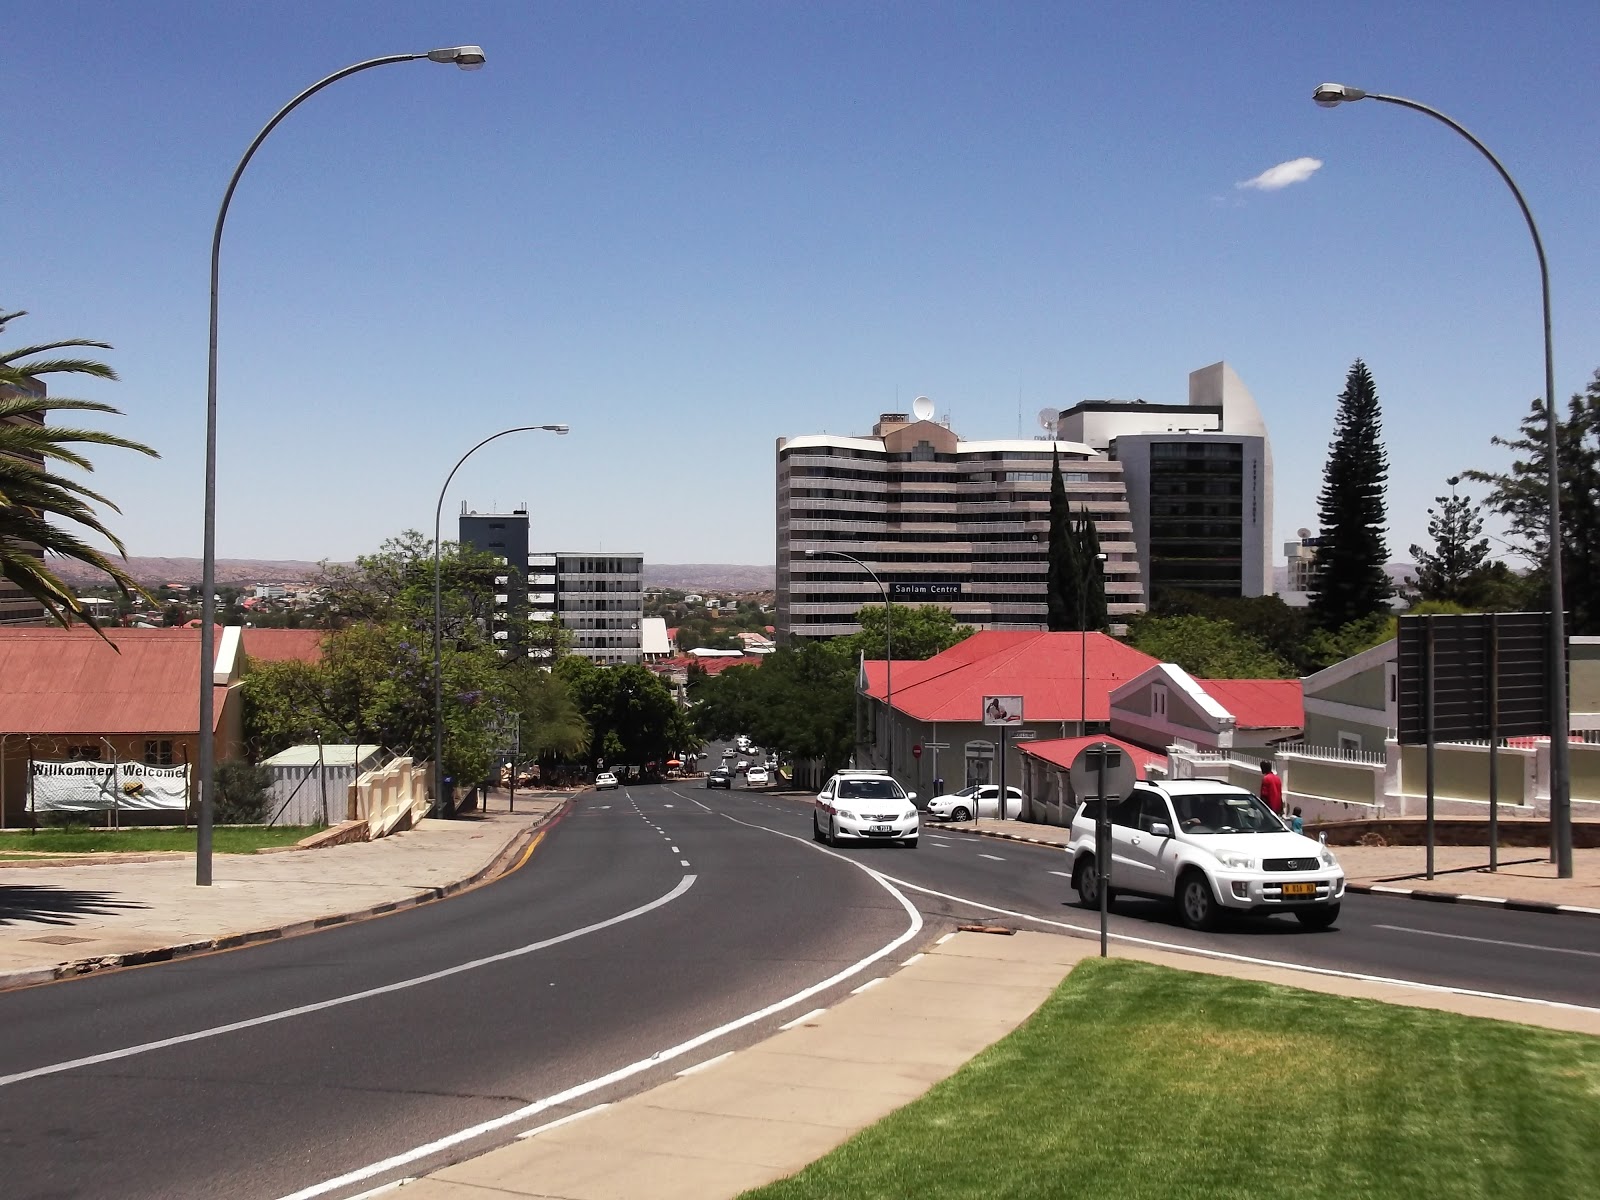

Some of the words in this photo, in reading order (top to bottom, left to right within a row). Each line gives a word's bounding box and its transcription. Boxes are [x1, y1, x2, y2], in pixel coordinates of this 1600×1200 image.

[895, 584, 927, 593] Sanlam
[930, 585, 958, 593] Centre
[32, 764, 113, 776] Willkommen
